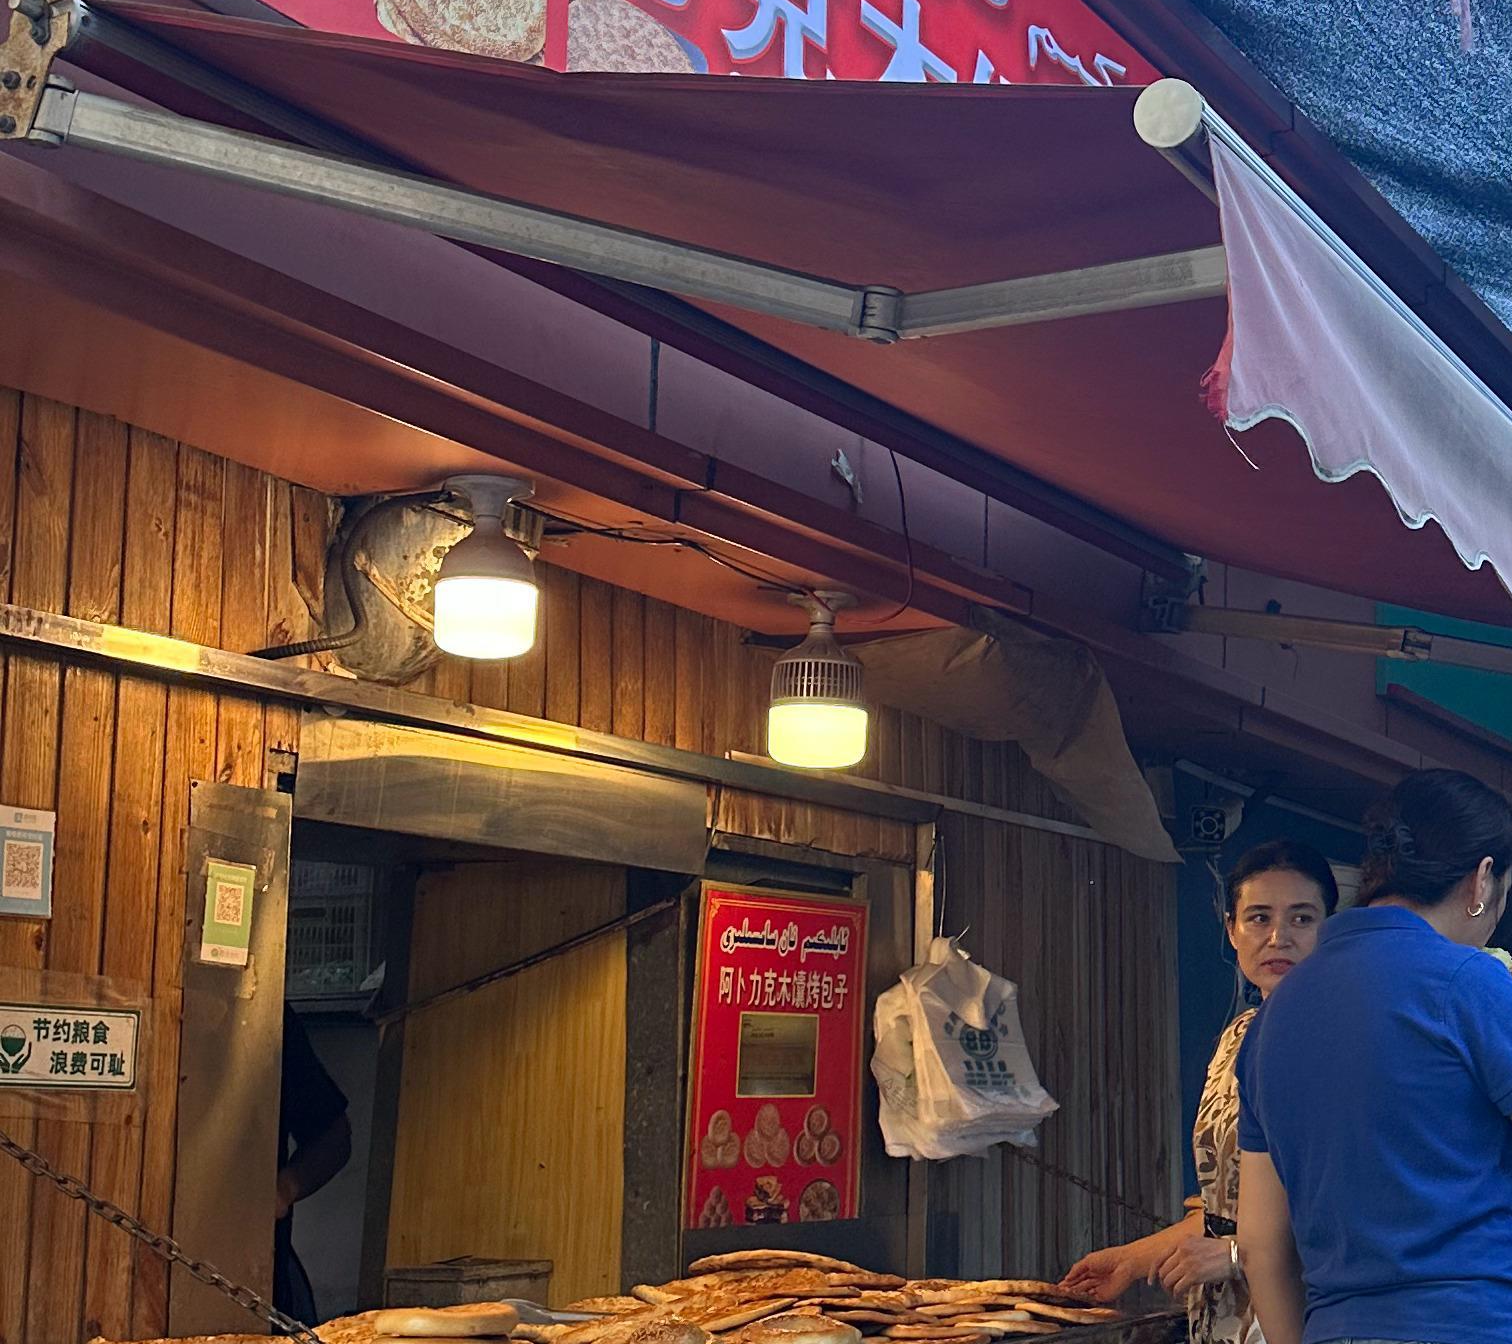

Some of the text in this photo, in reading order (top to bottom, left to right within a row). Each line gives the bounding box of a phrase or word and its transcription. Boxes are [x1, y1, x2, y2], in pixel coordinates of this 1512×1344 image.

[719, 966, 848, 1009] 阿卜力克木馕烤包子
[33, 1018, 110, 1045] 节约粮食
[49, 1050, 125, 1076] 浪费可耻
